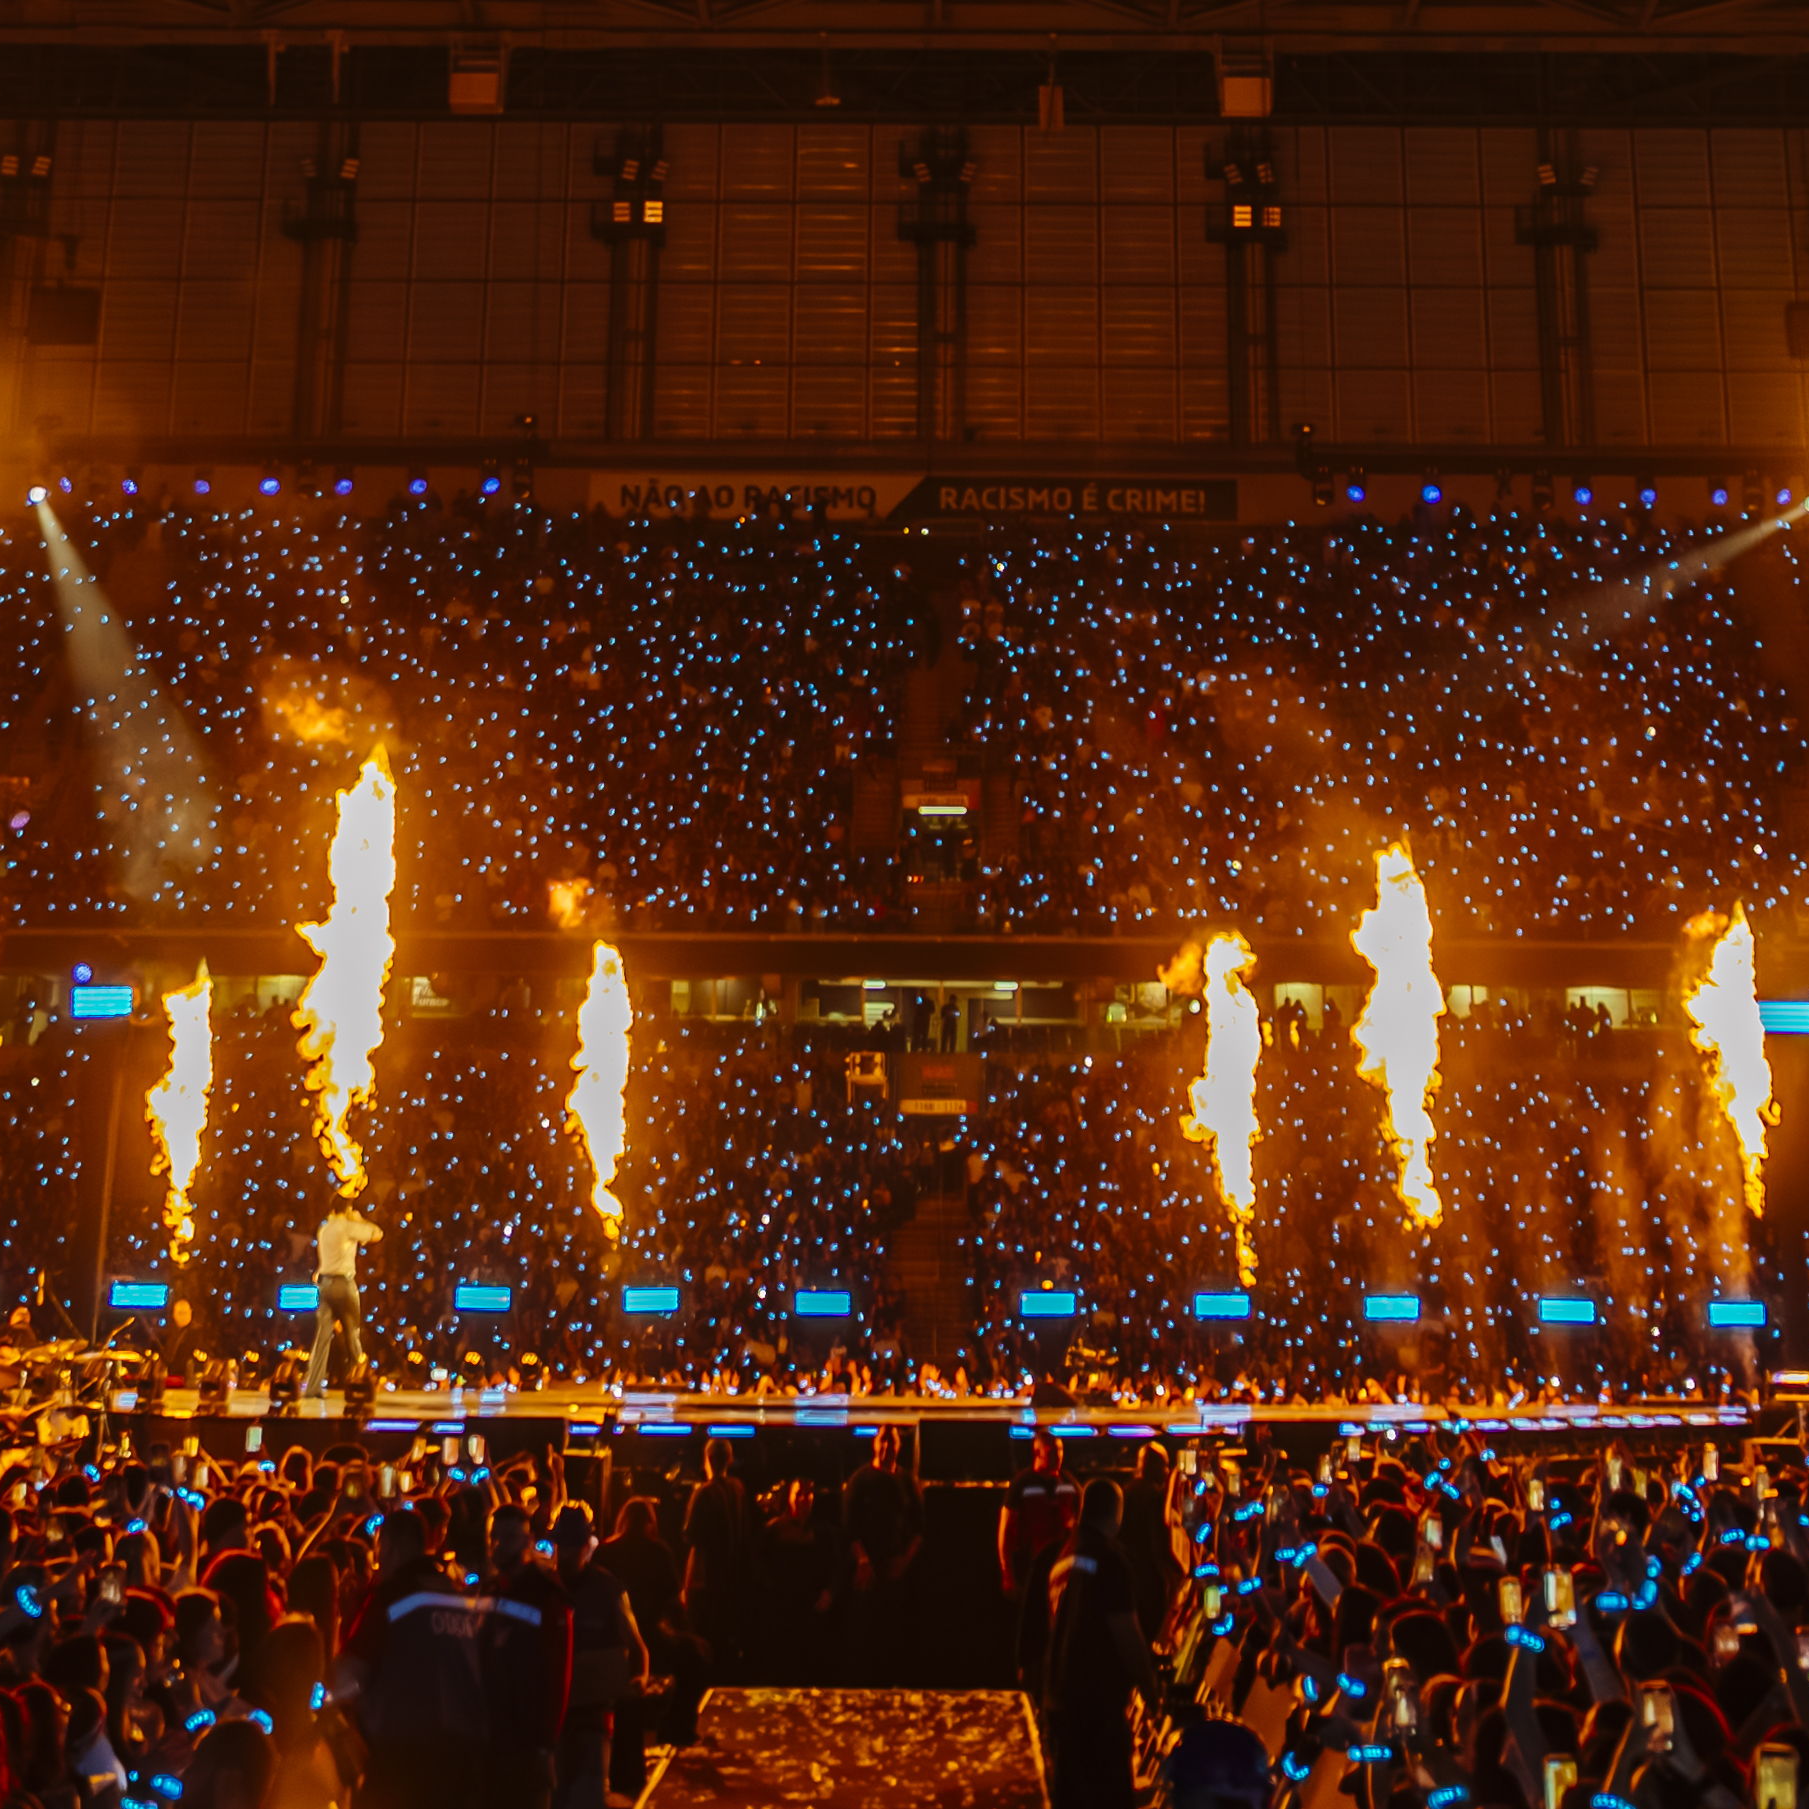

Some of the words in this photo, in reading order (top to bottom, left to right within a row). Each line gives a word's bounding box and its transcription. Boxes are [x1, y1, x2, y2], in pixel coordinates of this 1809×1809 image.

[620, 478, 684, 509] NÃO
[940, 486, 1073, 512] RACISMO
[1082, 481, 1099, 511] É
[1106, 487, 1206, 513] CRIME!
